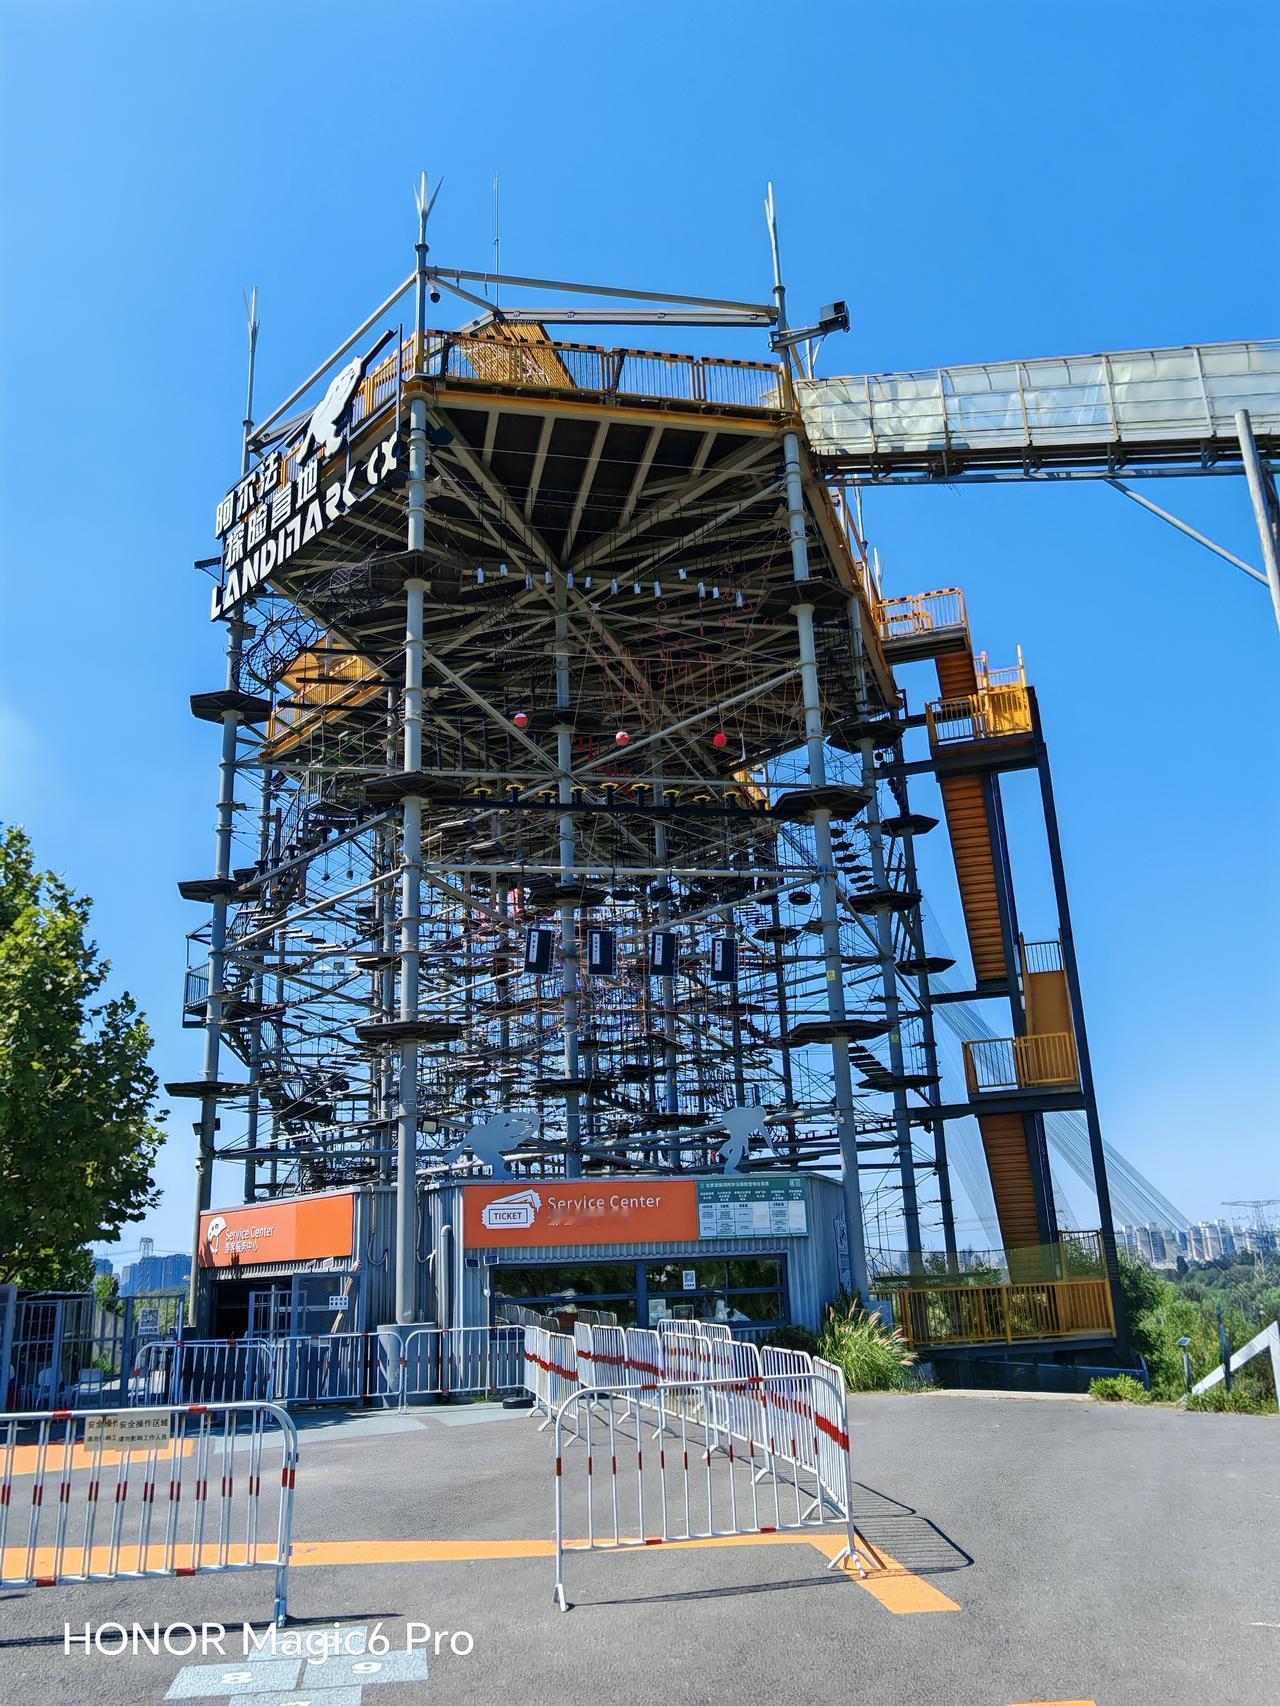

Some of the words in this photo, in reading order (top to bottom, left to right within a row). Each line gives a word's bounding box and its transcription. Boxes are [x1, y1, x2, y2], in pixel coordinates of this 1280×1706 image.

[215, 451, 282, 538] 阿尔法
[225, 458, 320, 571] 探险营地
[547, 1195, 605, 1210] Service
[610, 1195, 662, 1209] Center
[494, 1211, 522, 1221] TICKET
[225, 1230, 250, 1242] Service
[250, 1226, 275, 1239] Center
[119, 1418, 169, 1430] 安全操作区域
[118, 1433, 167, 1442] 请勿影响工作人员
[351, 1661, 383, 1675] 9
[221, 1671, 255, 1686] 8
